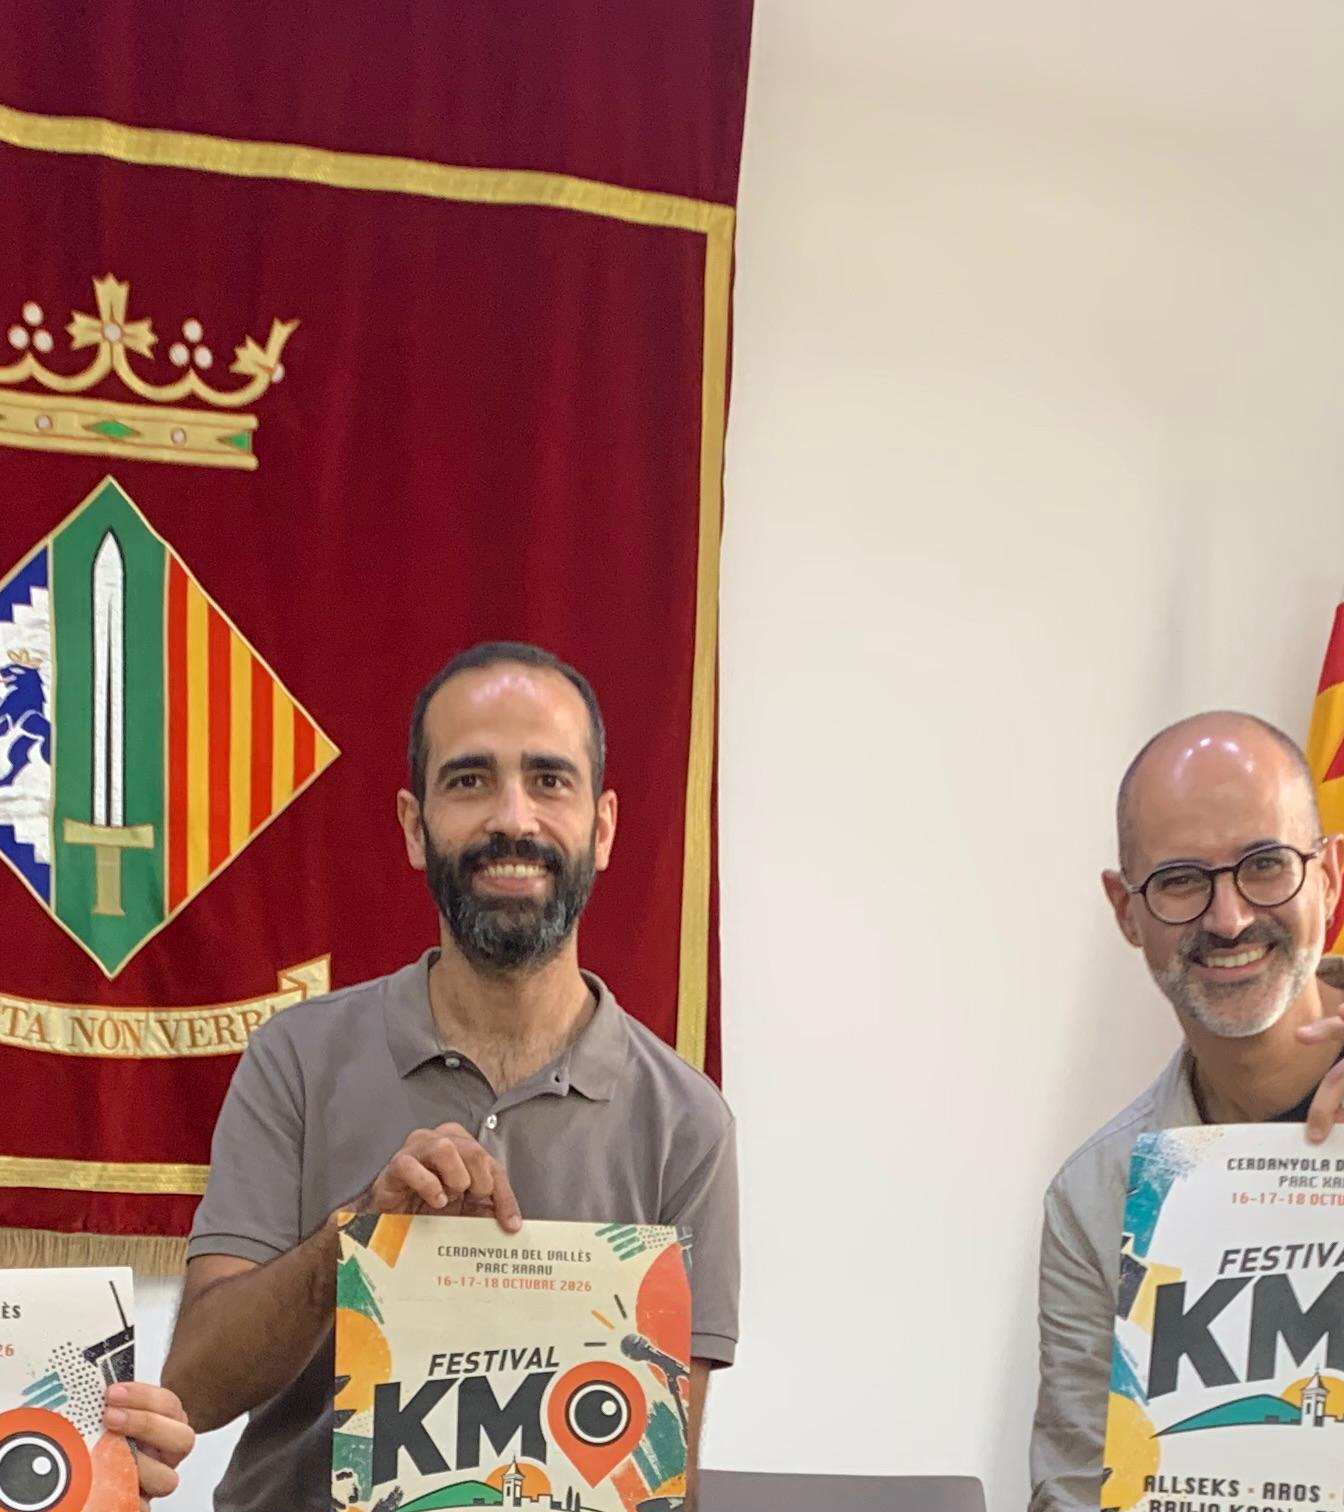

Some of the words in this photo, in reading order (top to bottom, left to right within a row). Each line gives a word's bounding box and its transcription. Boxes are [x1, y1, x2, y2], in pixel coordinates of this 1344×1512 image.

[68, 1015, 146, 1050] NON
[1227, 1158, 1330, 1171] CERDANYOLA
[1278, 1176, 1317, 1188] PARC
[1231, 1192, 1305, 1205] 16-17-18
[437, 1245, 518, 1259] CERDANYOLA
[522, 1249, 543, 1260] DEL
[476, 1263, 508, 1274] PARC
[512, 1264, 552, 1275] XARAU
[437, 1276, 498, 1287] 16-17-18
[502, 1278, 555, 1290] OCTUBRE
[560, 1280, 591, 1292] 2026
[428, 1346, 560, 1377] FESTIVAL
[1144, 1475, 1240, 1497] ALLSEKS
[1262, 1482, 1321, 1503] AROS
